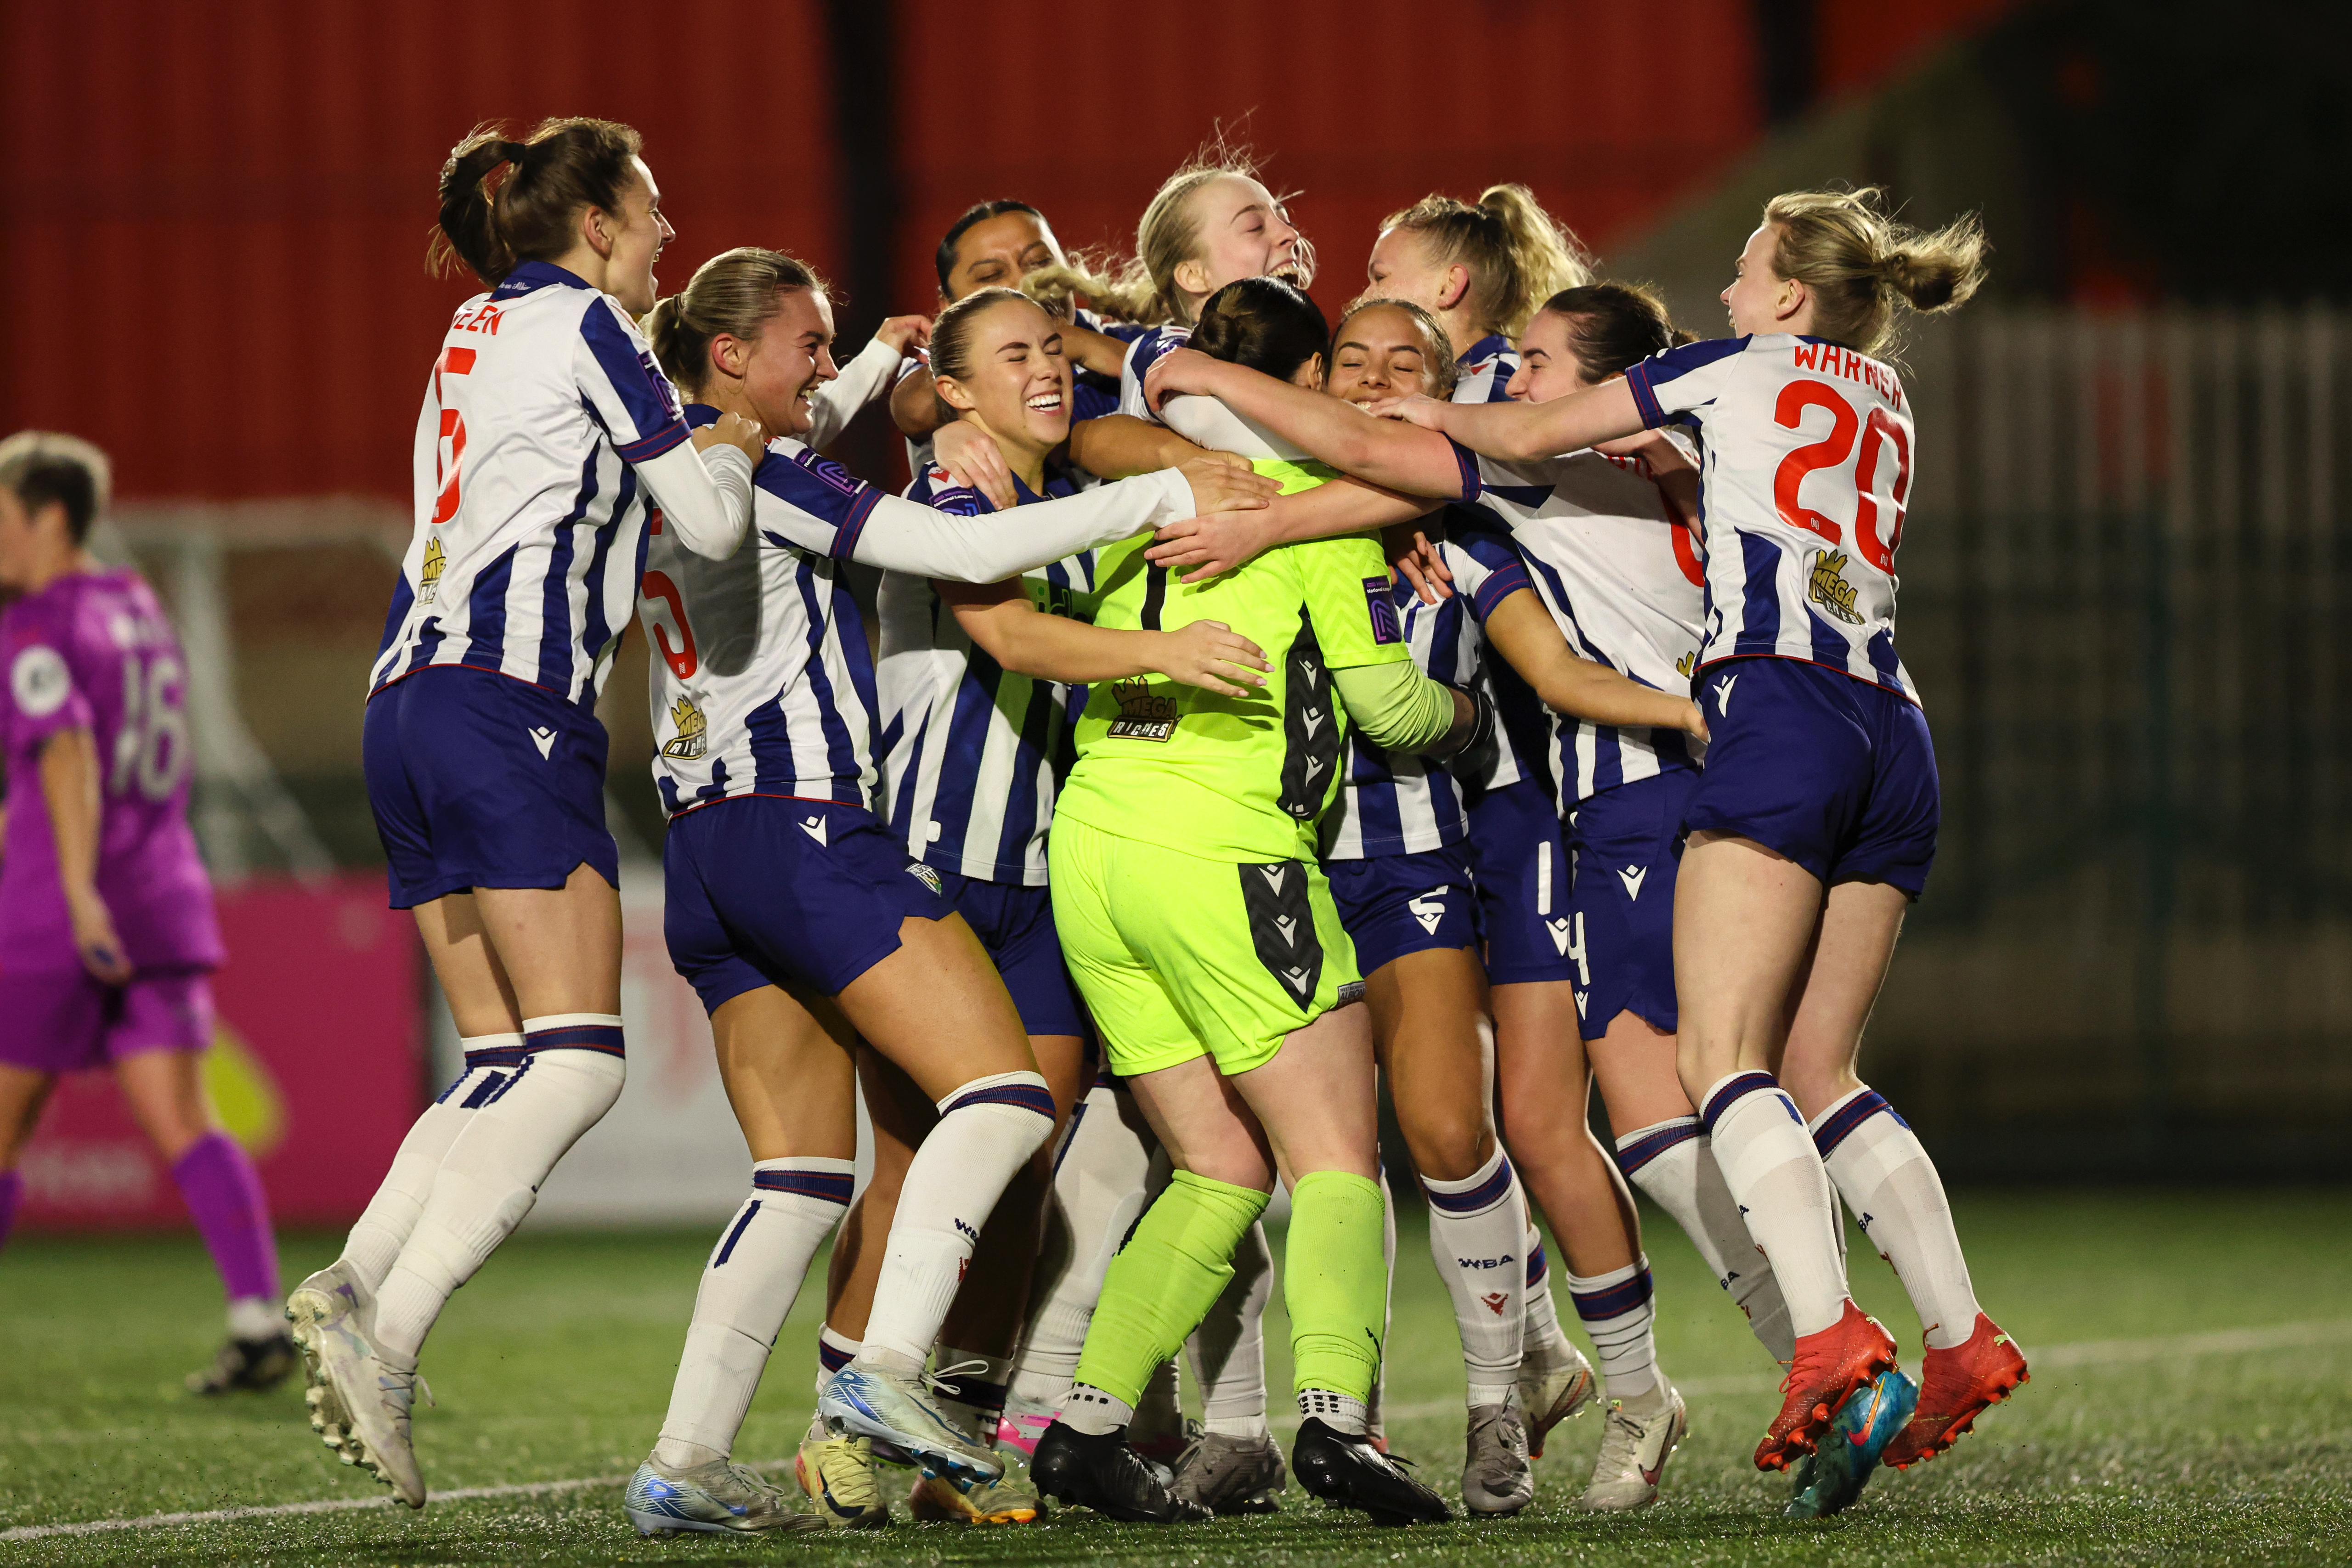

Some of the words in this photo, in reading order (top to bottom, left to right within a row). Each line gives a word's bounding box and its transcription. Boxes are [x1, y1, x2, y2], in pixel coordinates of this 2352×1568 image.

[1774, 379, 1910, 577] 20
[1812, 568, 1858, 613] MEGA
[1122, 695, 1177, 720] MEGA
[1113, 721, 1169, 737] RICHES
[1458, 1253, 1515, 1270] WBA
